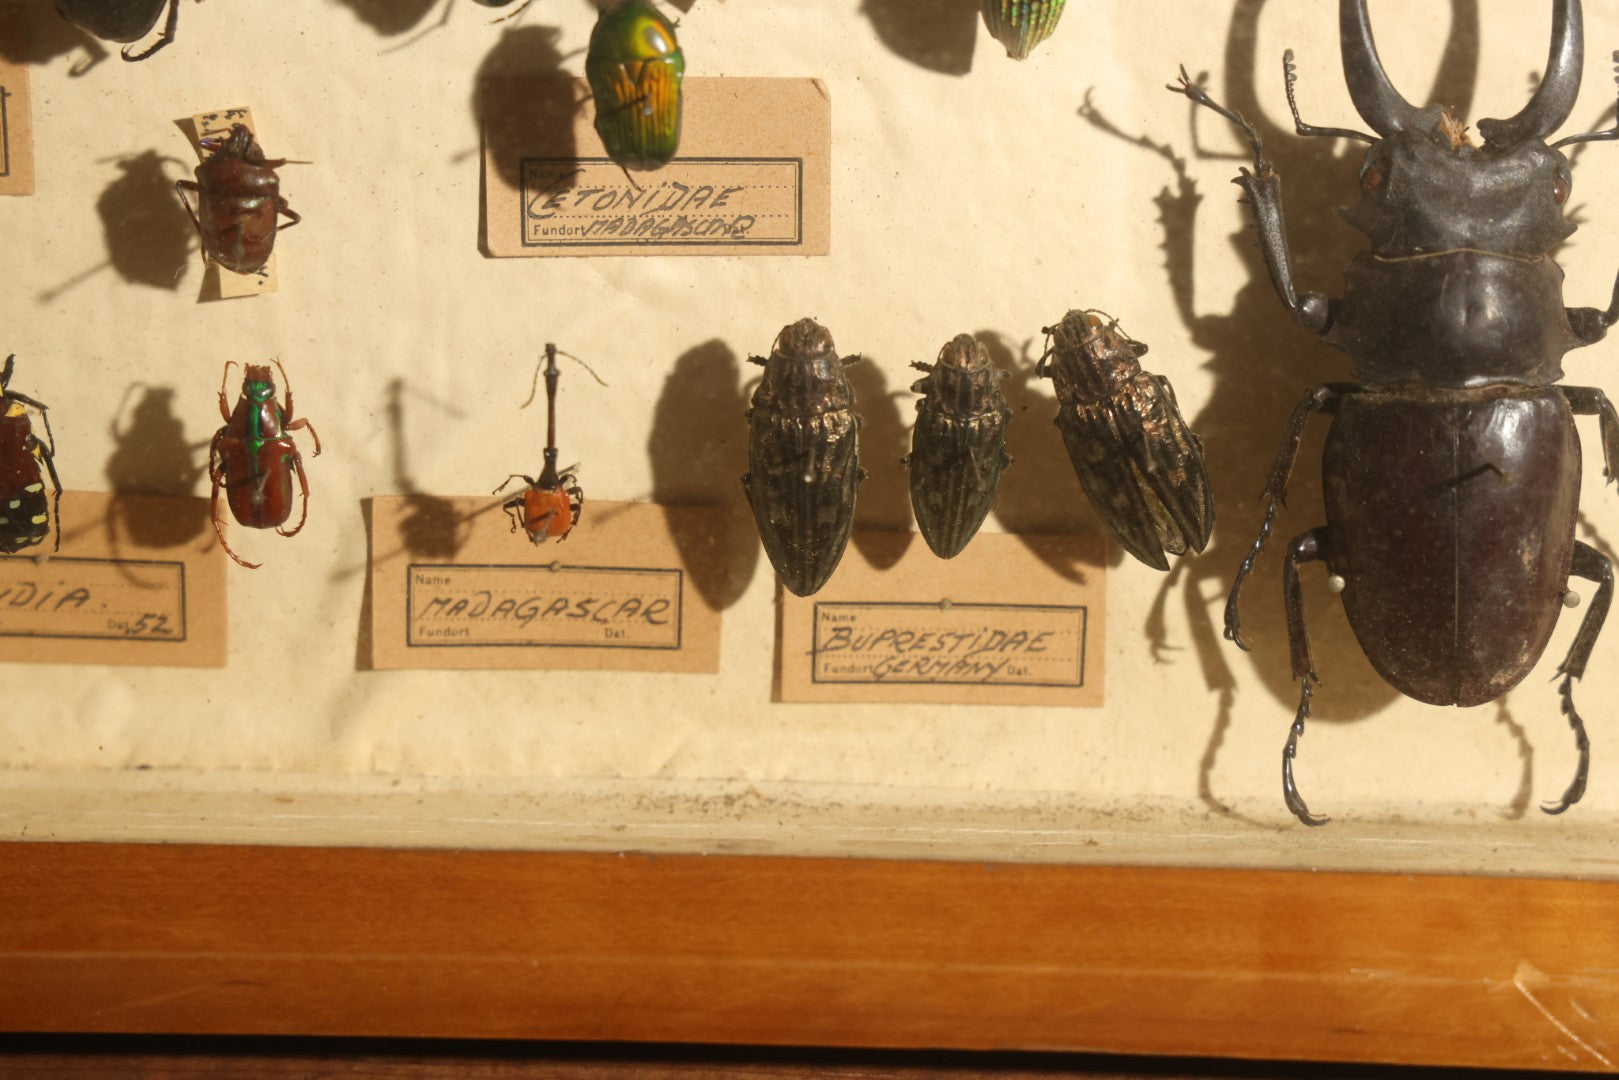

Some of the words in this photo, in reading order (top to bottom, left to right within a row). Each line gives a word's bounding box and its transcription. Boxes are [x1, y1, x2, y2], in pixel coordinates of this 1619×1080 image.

[533, 224, 586, 236] Fundort
[415, 574, 451, 585] Name
[416, 590, 671, 628] MADAGASCAR
[822, 612, 857, 623] Name
[419, 627, 469, 637] Fundort
[823, 663, 873, 674] Fundort
[871, 655, 1010, 683] GERMANY
